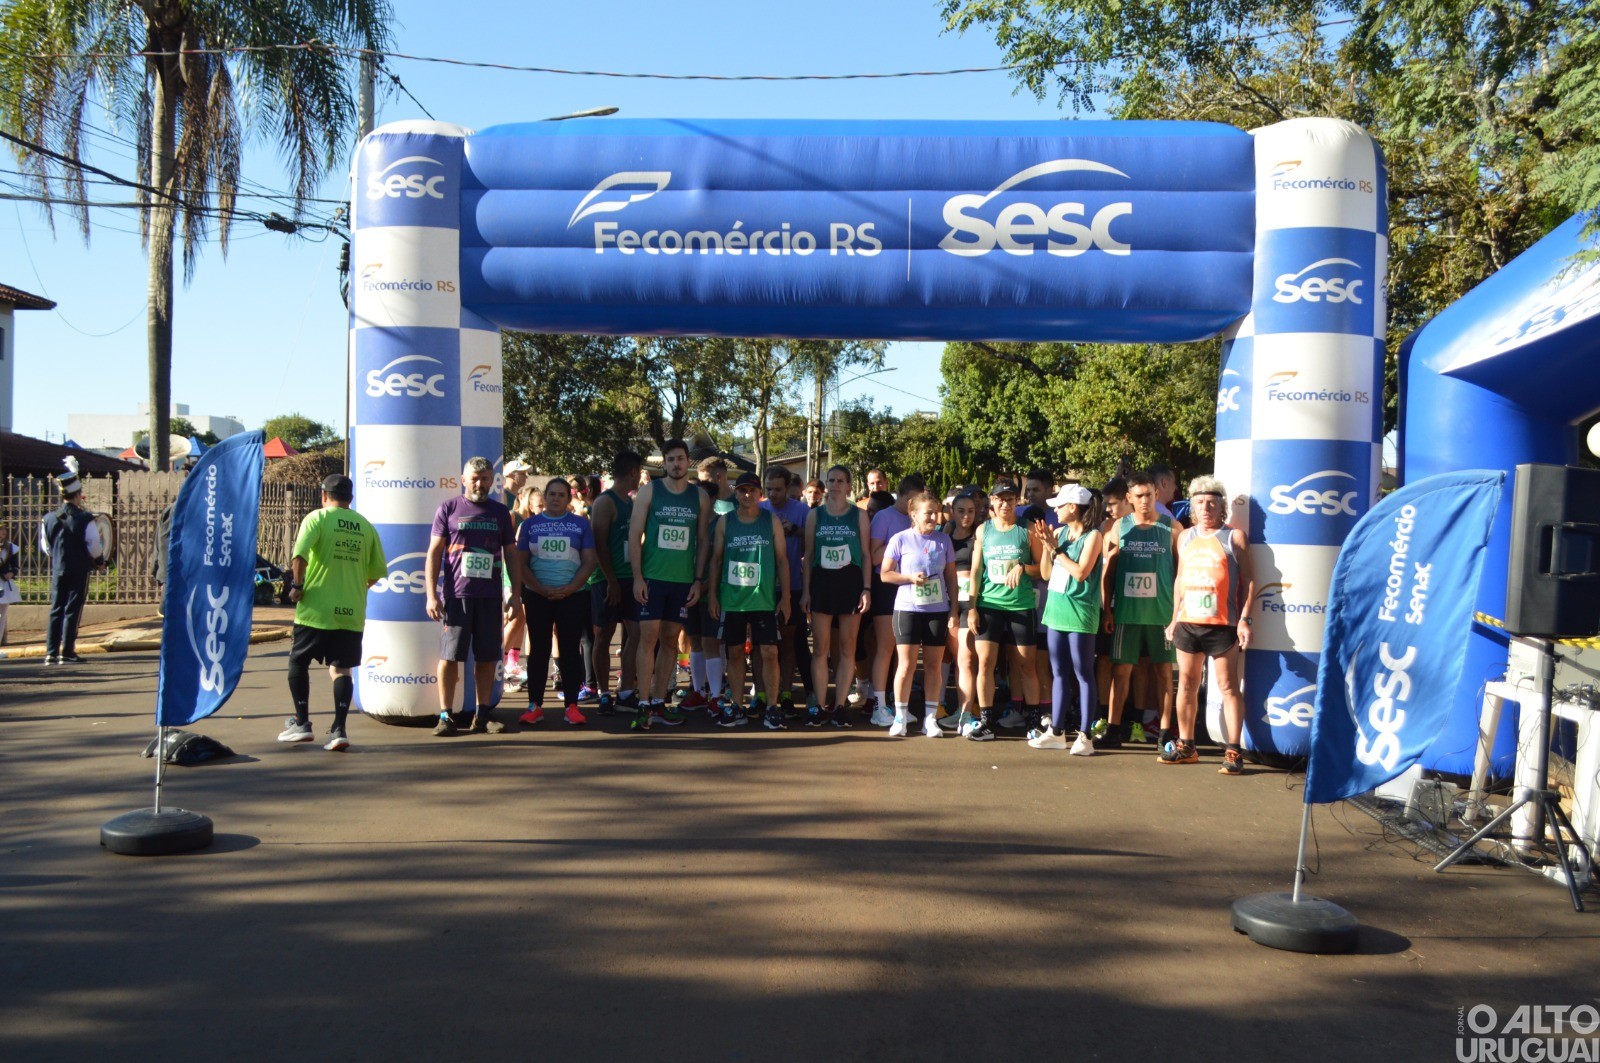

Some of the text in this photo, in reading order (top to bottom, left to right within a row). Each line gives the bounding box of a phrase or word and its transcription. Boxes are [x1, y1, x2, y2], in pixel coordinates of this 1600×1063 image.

[1272, 176, 1373, 194] Fecomércio RS
[593, 220, 883, 257] Fecomércio RS
[362, 278, 456, 293] Fecomércio RS
[1268, 389, 1369, 404] Fecomércio RS
[365, 476, 458, 489] Fecomércio RS
[204, 464, 217, 566] Fecomércio
[457, 521, 498, 530] UNIMED
[219, 513, 233, 567] Senac
[662, 528, 686, 543] 694
[541, 538, 567, 553] 490
[1144, 546, 1166, 554] BONITO
[825, 548, 846, 562] 497
[466, 555, 490, 571] 558
[1378, 504, 1416, 622] Fecomércio
[731, 564, 755, 579] 496
[915, 582, 939, 598] 554
[1127, 575, 1152, 590] 470
[1405, 562, 1432, 625] Senac
[368, 672, 437, 684] Fecomércio
